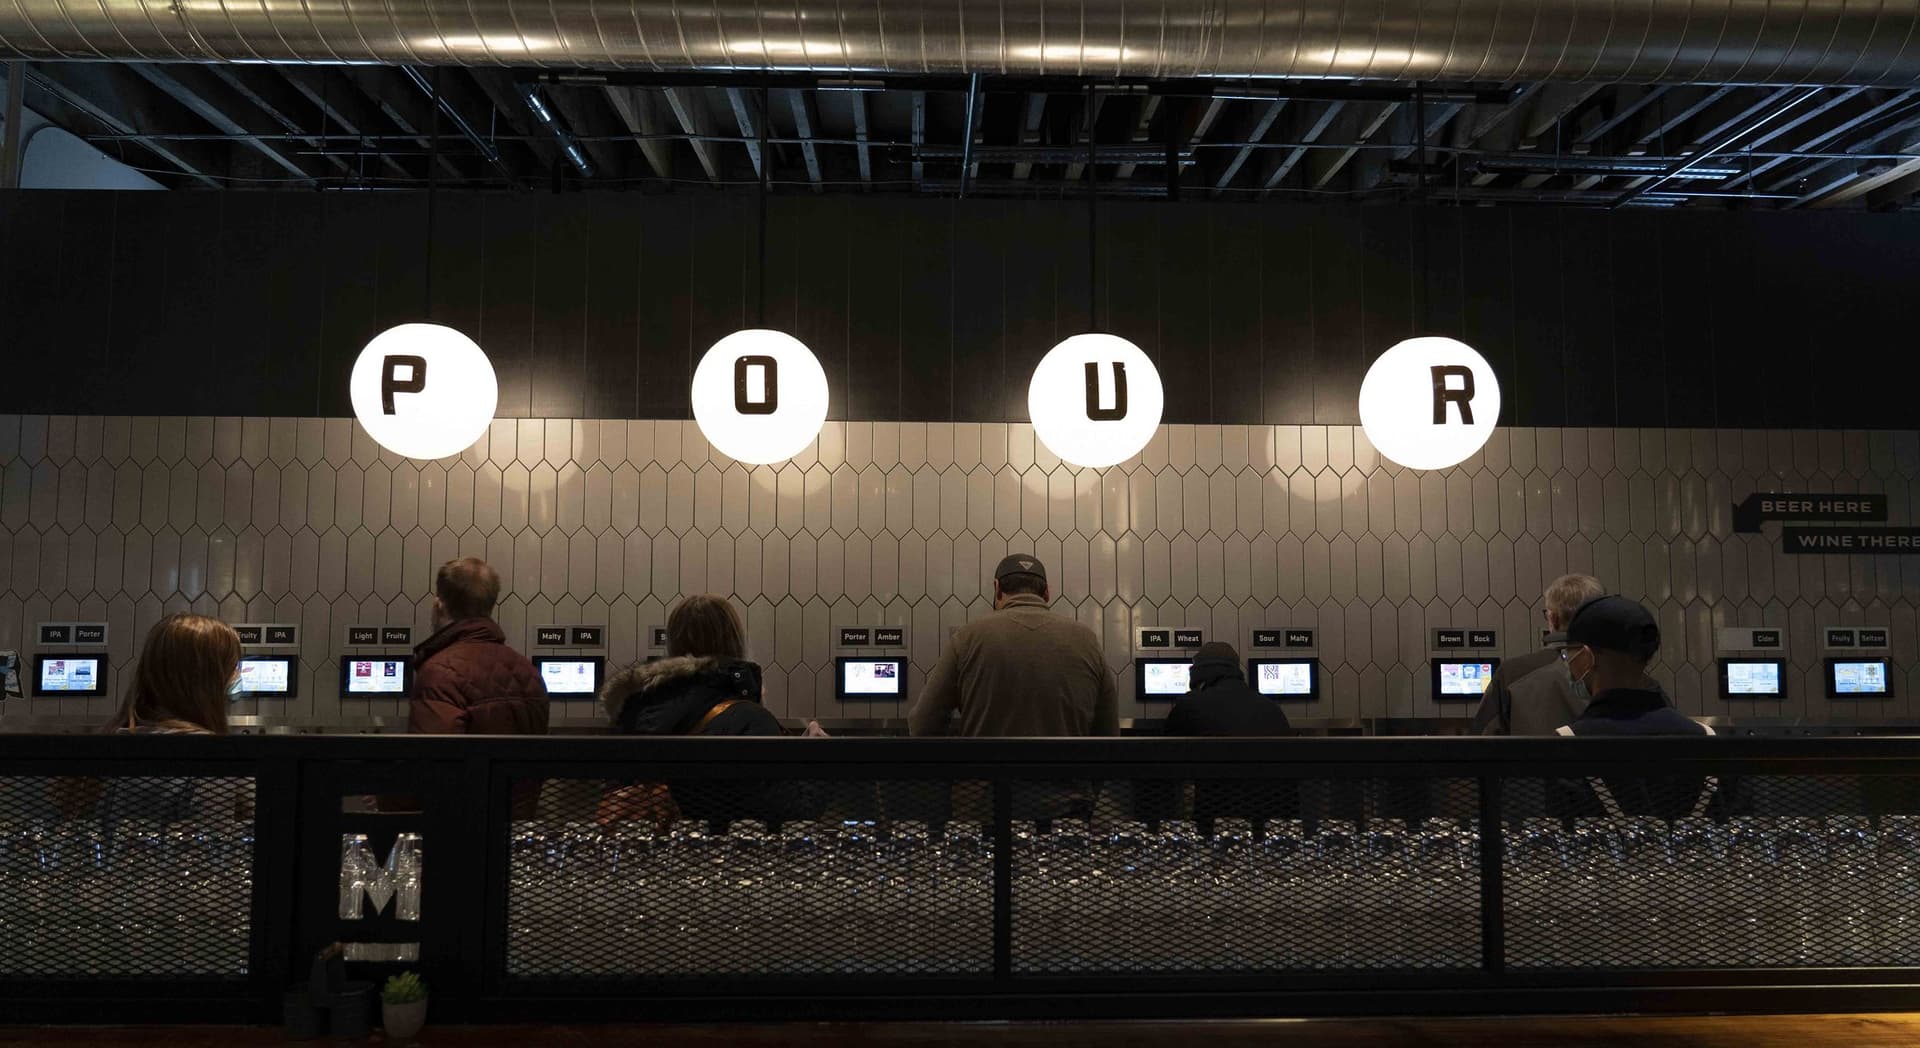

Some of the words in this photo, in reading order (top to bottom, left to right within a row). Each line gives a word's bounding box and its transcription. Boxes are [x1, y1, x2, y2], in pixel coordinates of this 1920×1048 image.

[381, 354, 427, 415] P
[1761, 501, 1813, 513] BEER
[1819, 502, 1872, 513] HERE
[1798, 535, 1853, 547] WINE
[1858, 536, 1920, 547] THERE
[50, 630, 62, 638] IPA
[78, 630, 101, 638] Porter
[274, 631, 286, 639] IPA
[355, 632, 372, 641] Light
[386, 632, 406, 641] Fruity
[542, 633, 561, 642] Malty
[580, 632, 592, 640] IPA
[844, 633, 866, 641] Porter
[877, 633, 900, 641] Amber
[1150, 634, 1161, 642] IPA
[1177, 634, 1199, 642] Wheat
[1258, 634, 1275, 642] Sour
[1757, 634, 1775, 642] Cider
[1861, 634, 1884, 642] Seltzer
[1290, 634, 1308, 643] Malty
[1831, 634, 1850, 643] Fruity
